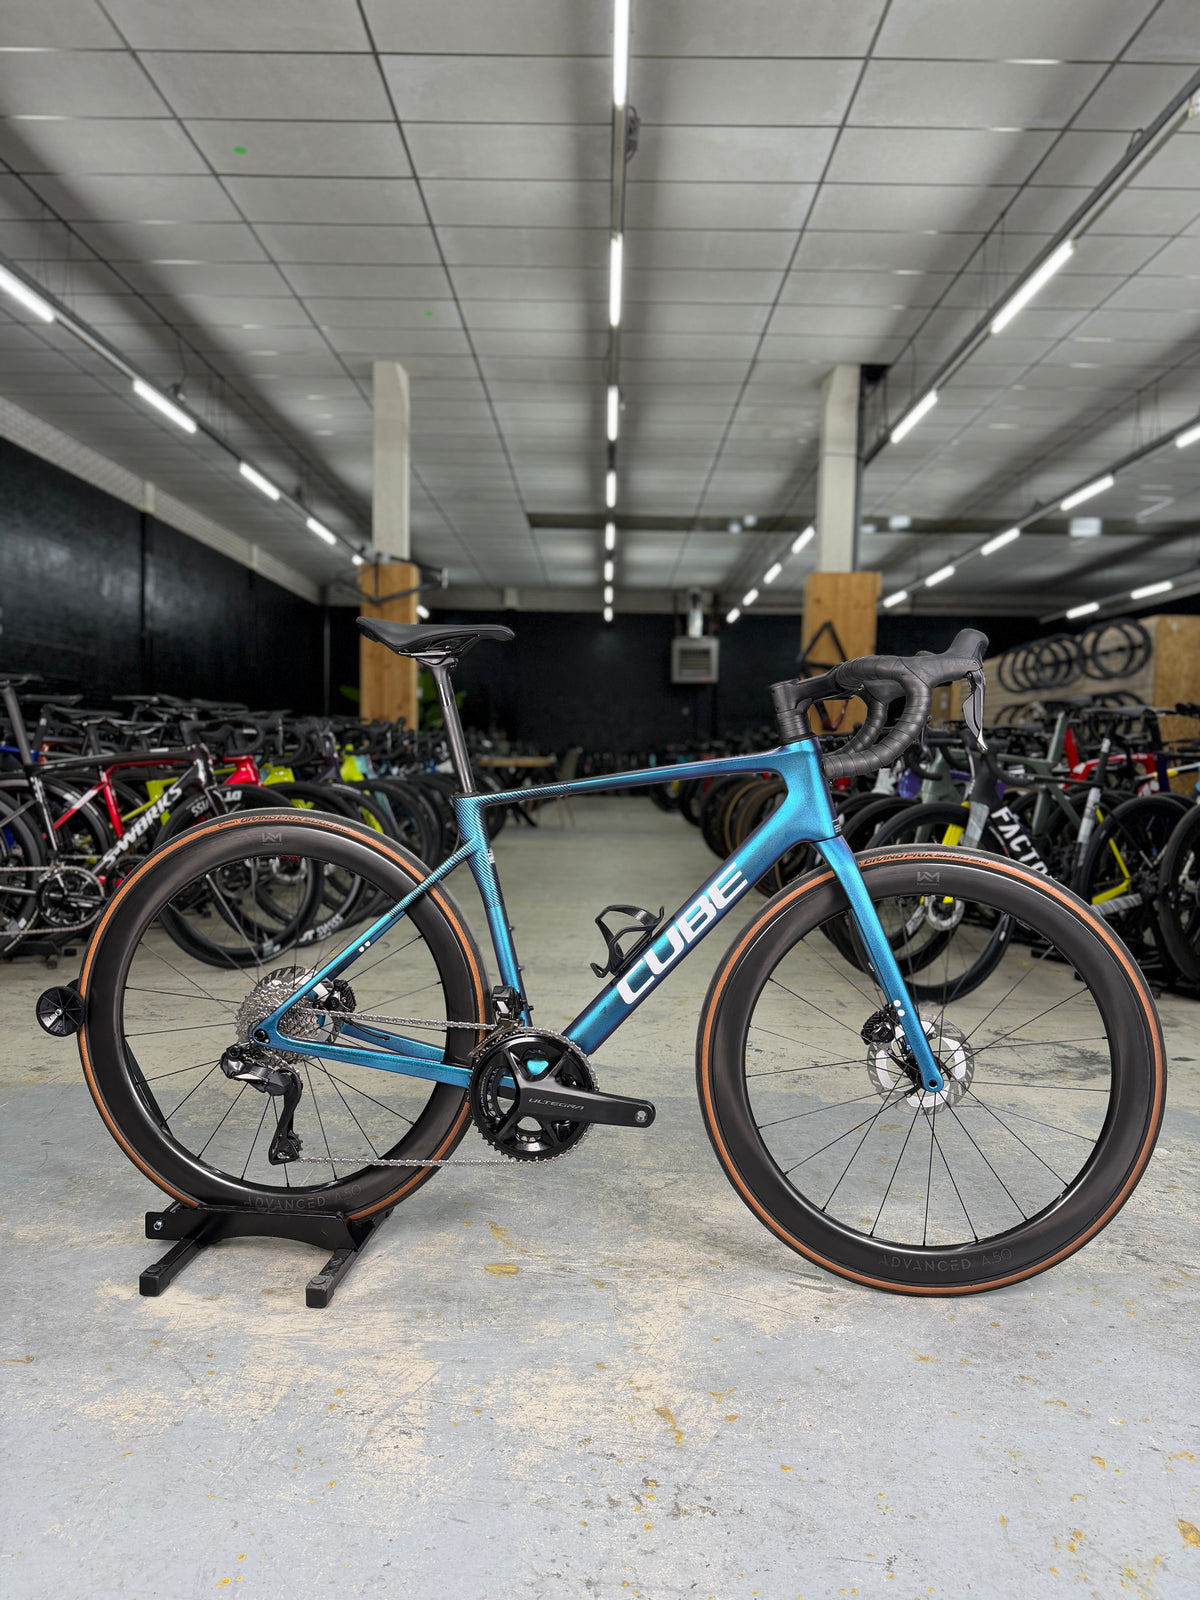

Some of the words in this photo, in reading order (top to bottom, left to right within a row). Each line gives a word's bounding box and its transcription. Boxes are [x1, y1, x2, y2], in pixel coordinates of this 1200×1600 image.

[102, 783, 183, 870] S-WORKS
[990, 806, 1057, 879] FACTO
[863, 853, 905, 866] GRAND
[316, 912, 344, 938] SWISS
[616, 861, 749, 1005] CUBE
[528, 1097, 585, 1111] ULTEGRA
[244, 1194, 326, 1211] ADVANCED
[878, 1253, 972, 1273] ADVANCED
